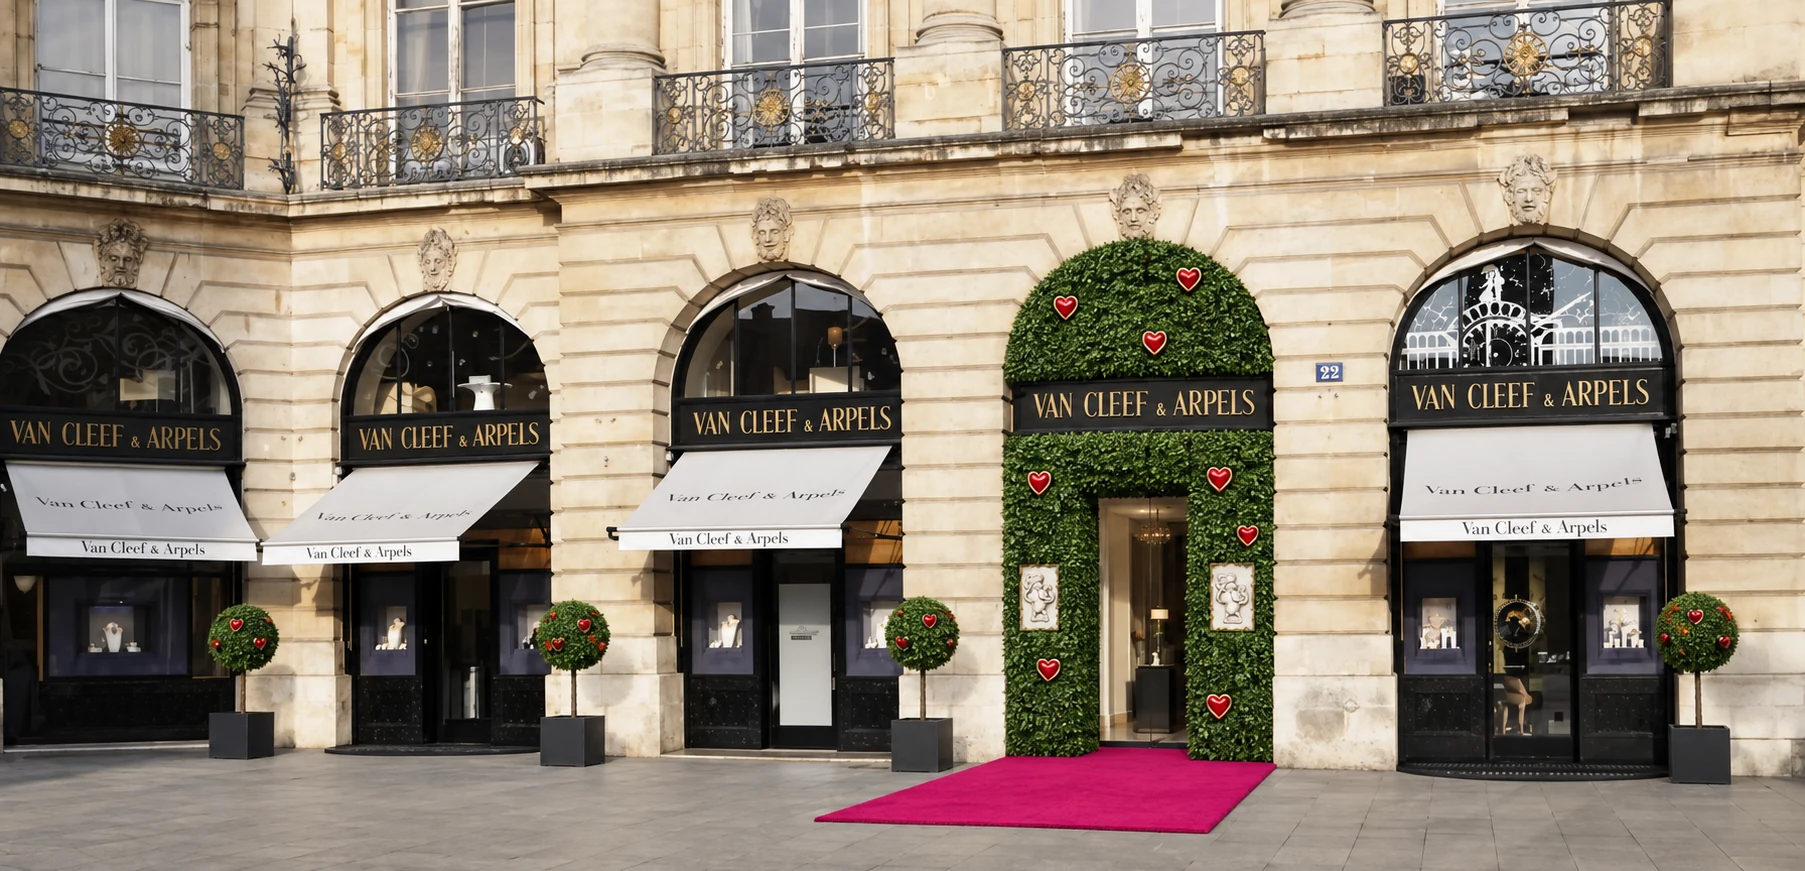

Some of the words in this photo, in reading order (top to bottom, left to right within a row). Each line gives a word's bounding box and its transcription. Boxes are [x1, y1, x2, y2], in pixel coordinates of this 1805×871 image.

[1320, 366, 1339, 379] 22
[1412, 384, 1454, 409] VAN
[1468, 382, 1535, 409] CLEEF
[1544, 394, 1554, 406] &
[1562, 379, 1649, 406] ARPELS
[1034, 393, 1072, 418] VAN
[1084, 391, 1148, 417] CLEEF
[1157, 403, 1166, 416] &
[1173, 390, 1254, 415] ARPELS
[694, 412, 729, 435] VAN
[740, 409, 797, 434] CLEEF
[804, 420, 812, 432] &
[819, 406, 891, 431] ARPELS
[11, 420, 50, 444] VAN
[62, 422, 124, 447] CLEEF
[131, 436, 139, 448] &
[147, 427, 221, 450] ARPELS
[360, 428, 392, 450] VAN
[401, 426, 453, 449] CLEEF
[459, 435, 467, 447] &
[473, 422, 539, 446] ARPELS
[667, 493, 701, 502] Van
[706, 491, 761, 501] Cleef
[782, 488, 847, 501] Arpels
[1424, 485, 1466, 495] Van
[1473, 484, 1535, 495] Cleef
[1567, 477, 1643, 493] Arpels
[35, 496, 74, 508] Van
[79, 500, 133, 510] Cleef
[141, 503, 155, 511] &
[160, 503, 224, 515] Arpels
[1462, 521, 1491, 535] Van
[1494, 520, 1537, 535] Cleef
[1541, 523, 1553, 534] &
[1556, 518, 1608, 538] Arpels
[669, 532, 693, 546] Van
[696, 532, 731, 545] Cleef
[734, 535, 743, 545] &
[746, 531, 789, 548] Arpels
[81, 541, 108, 554] Van
[110, 541, 148, 554] Cleef
[150, 545, 160, 555] &
[162, 542, 206, 559] Arpels
[306, 547, 328, 560] Van
[330, 546, 363, 559] Cleef
[364, 548, 372, 558] &
[374, 544, 413, 561] Arpels
